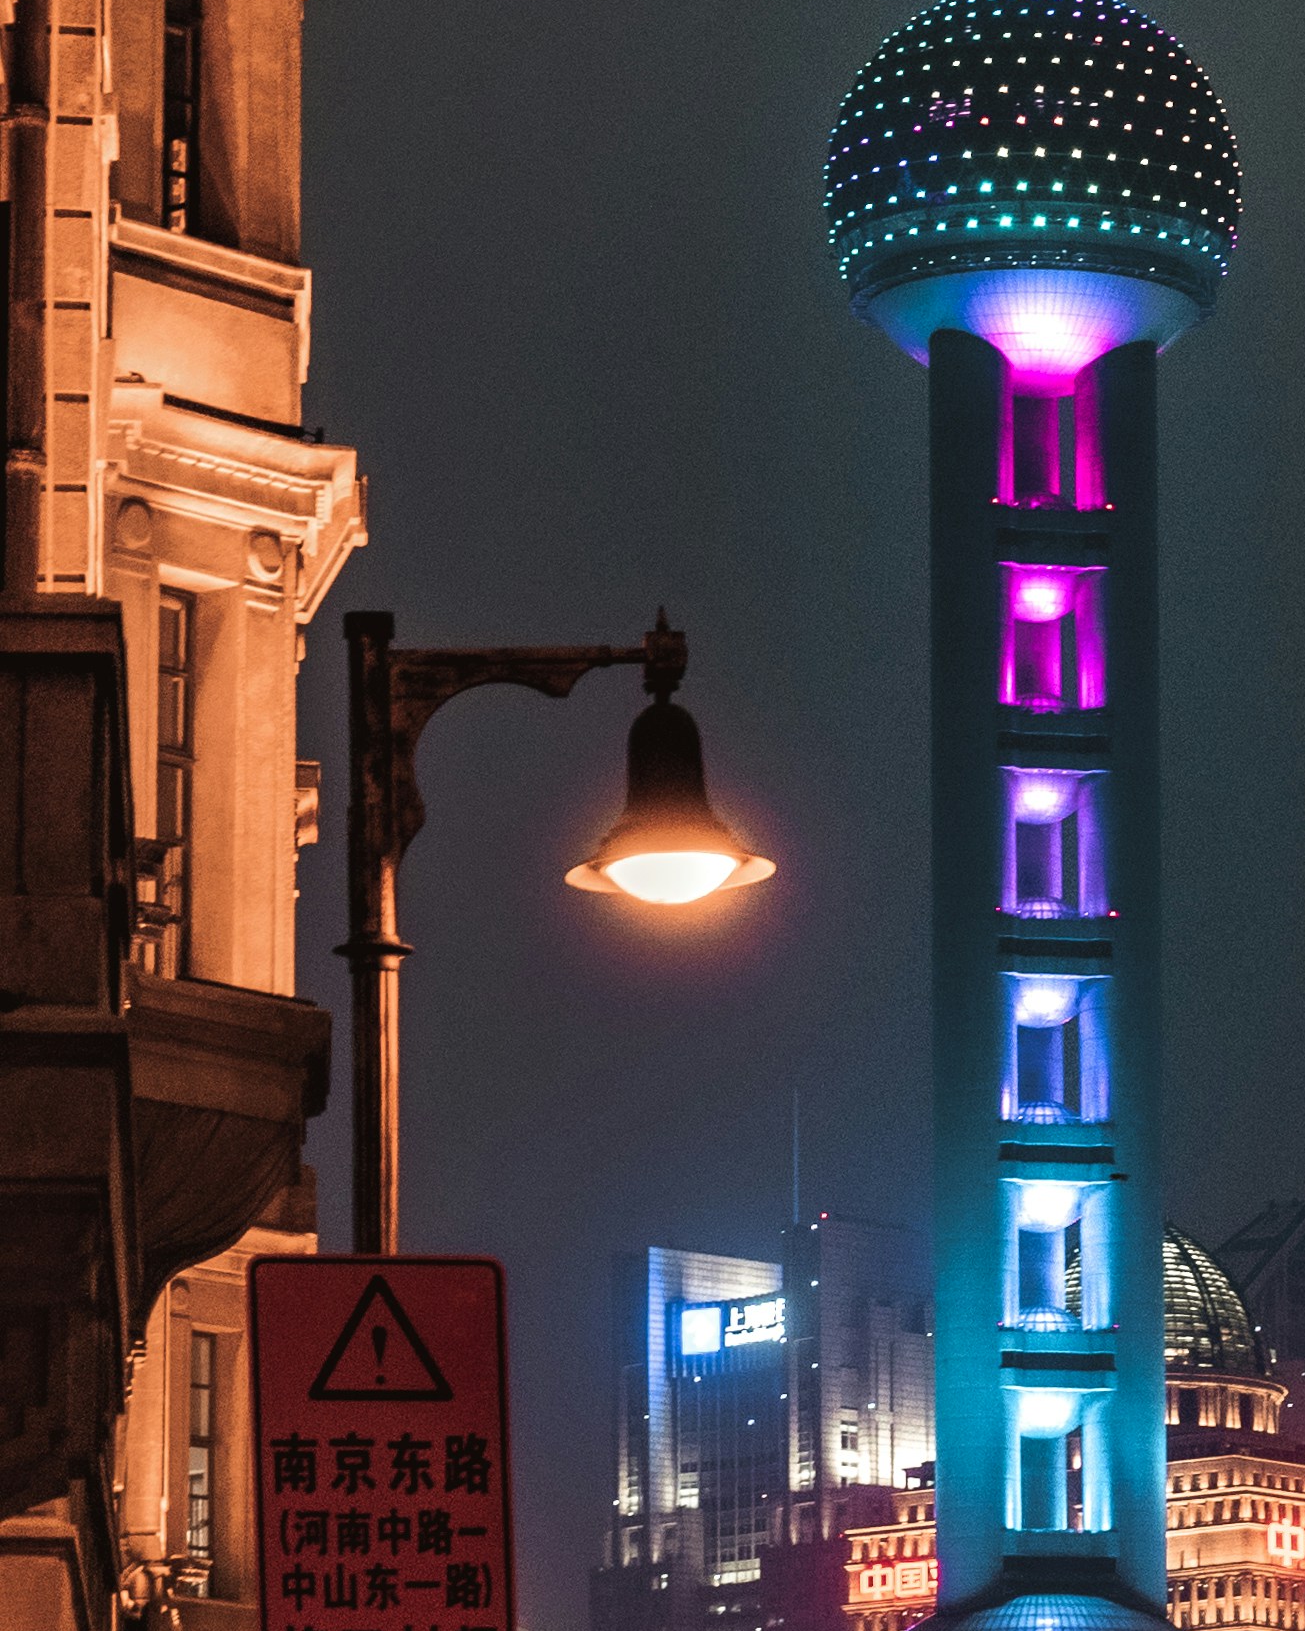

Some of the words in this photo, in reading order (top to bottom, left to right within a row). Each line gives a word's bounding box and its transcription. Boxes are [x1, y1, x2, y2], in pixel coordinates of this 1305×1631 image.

[269, 1432, 492, 1496] 南京东路
[279, 1565, 493, 1612] 中山东一路)
[859, 1560, 939, 1600] 中国
